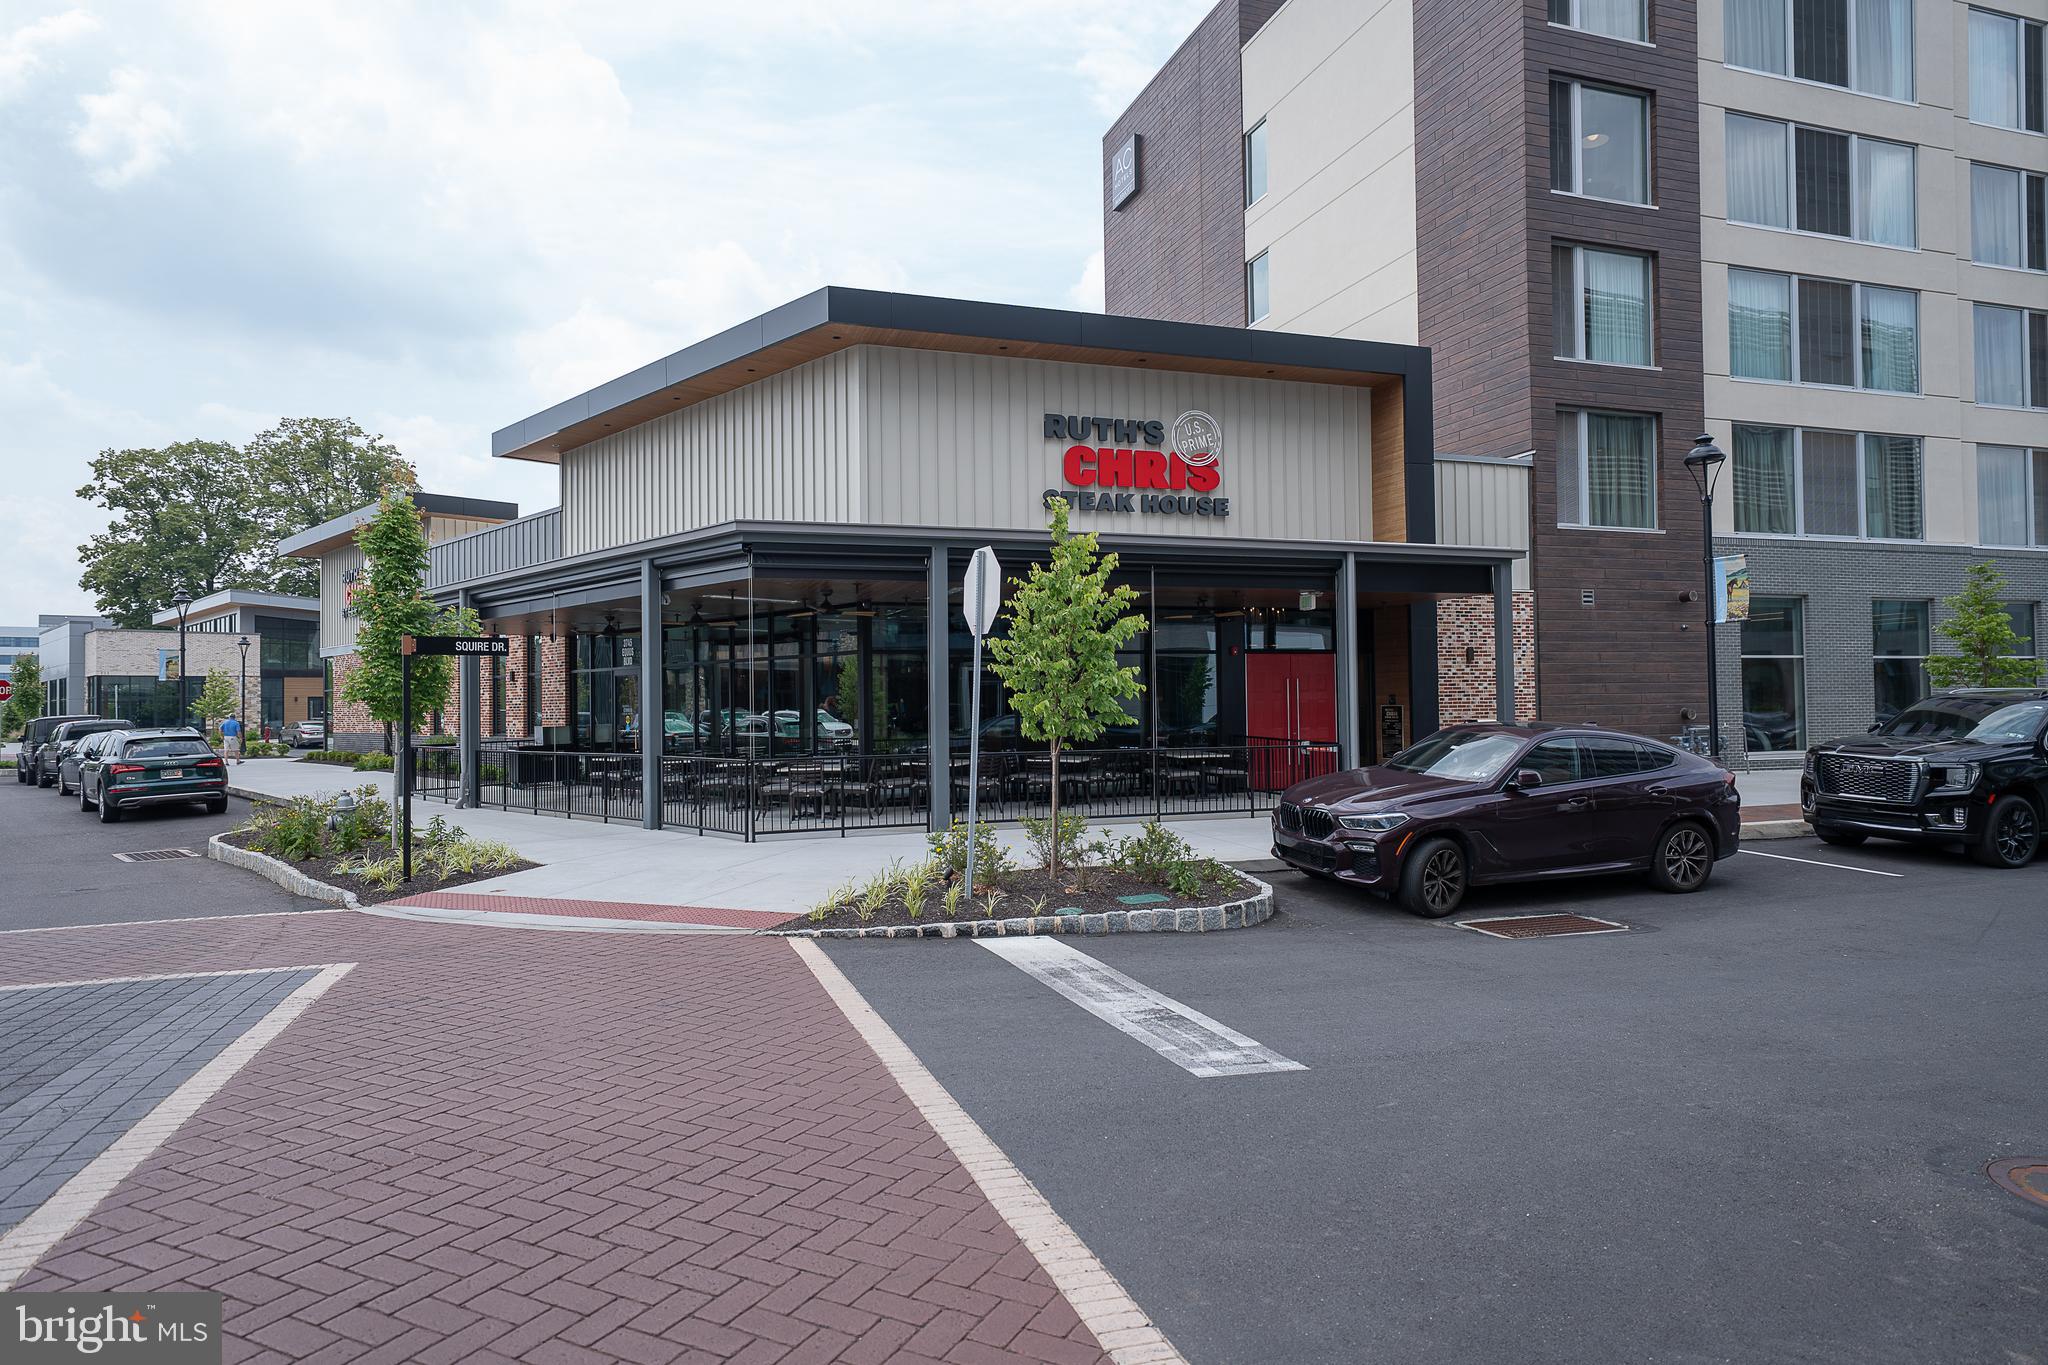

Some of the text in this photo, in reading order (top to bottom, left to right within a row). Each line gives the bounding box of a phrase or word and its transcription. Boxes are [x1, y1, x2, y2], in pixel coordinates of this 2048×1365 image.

[1115, 147, 1132, 180] AC
[1044, 413, 1165, 445] RUTH'S
[1184, 421, 1204, 436] U.S.
[1181, 433, 1214, 453] PRIME
[1063, 445, 1221, 492] CHRIS
[1042, 489, 1230, 516] STEAK HOUSE
[455, 641, 507, 652] SQUIRE DR.
[0, 686, 12, 695] OP
